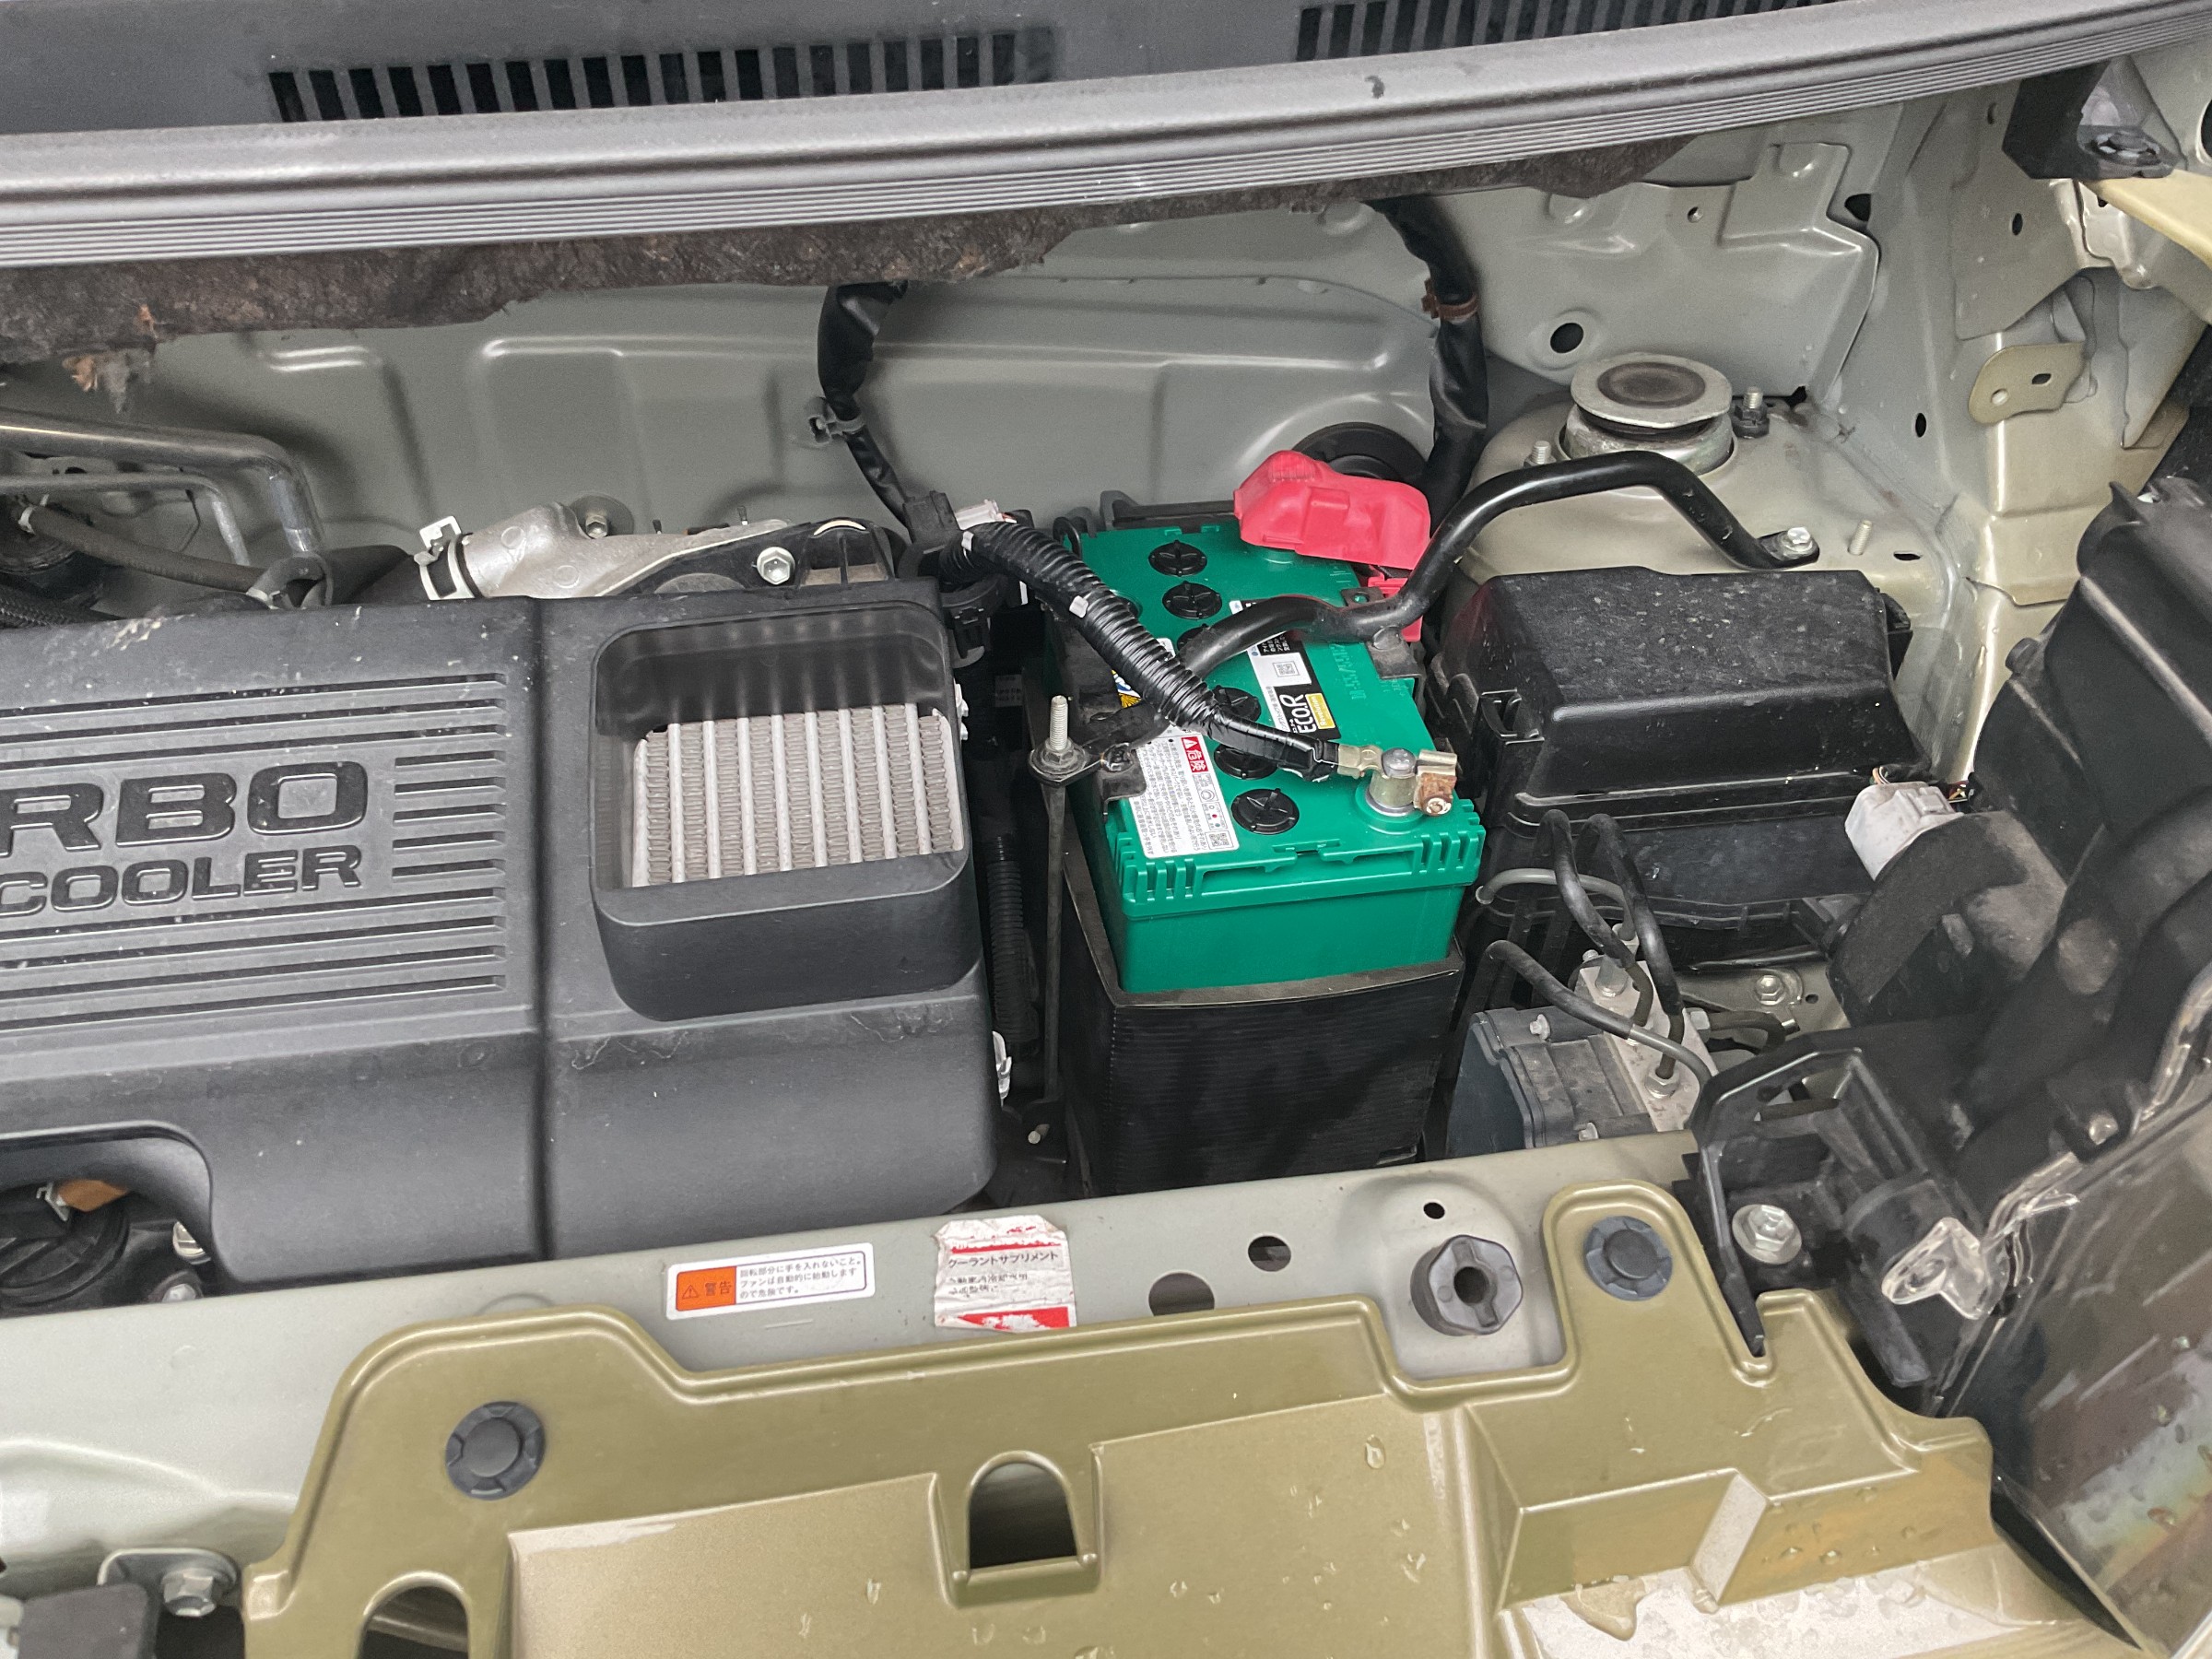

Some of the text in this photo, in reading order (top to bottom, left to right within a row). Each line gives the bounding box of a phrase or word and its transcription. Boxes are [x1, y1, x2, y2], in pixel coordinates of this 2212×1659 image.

[1278, 694, 1318, 734] ECO.R
[1311, 696, 1327, 726] Revolution
[1186, 749, 1206, 771] 危険
[704, 1280, 732, 1297] 警告
